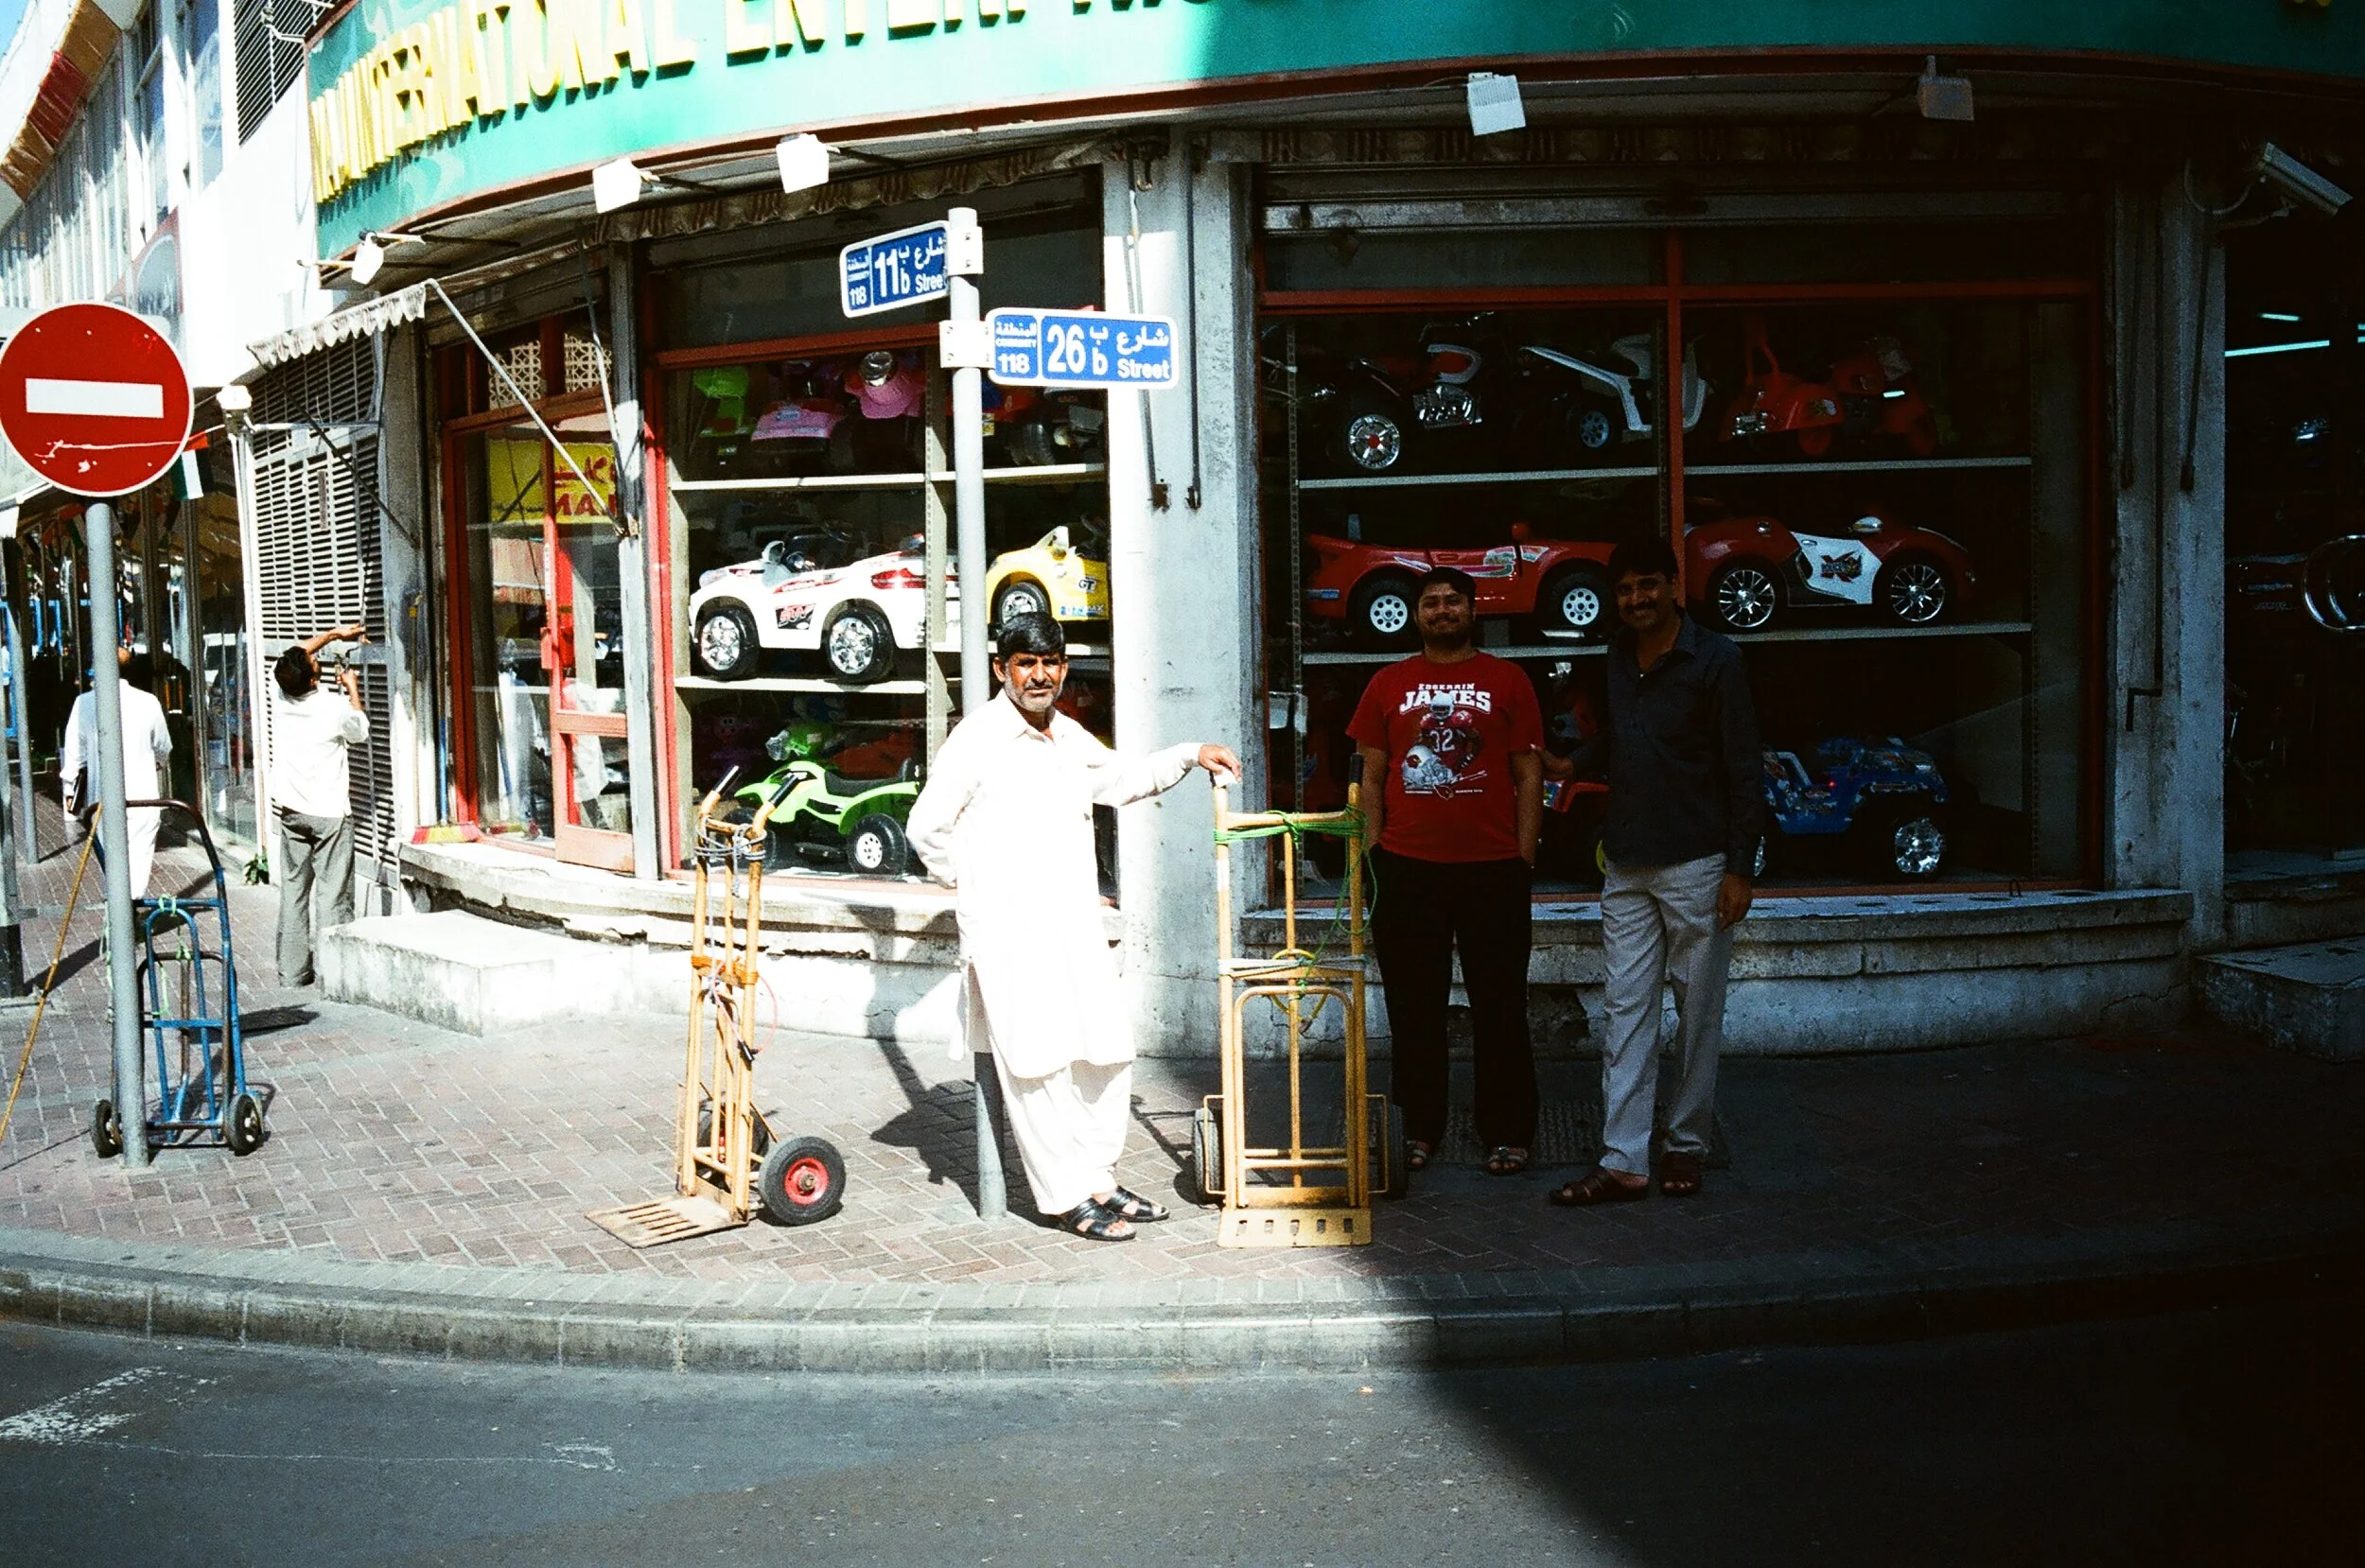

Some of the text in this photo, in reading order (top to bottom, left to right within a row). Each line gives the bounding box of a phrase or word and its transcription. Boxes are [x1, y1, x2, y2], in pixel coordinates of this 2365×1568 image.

[850, 286, 867, 306] 118
[1116, 324, 1169, 356] شارع
[998, 353, 1030, 375] 118
[1117, 357, 1169, 379] Street
[1399, 689, 1491, 715] JAMES
